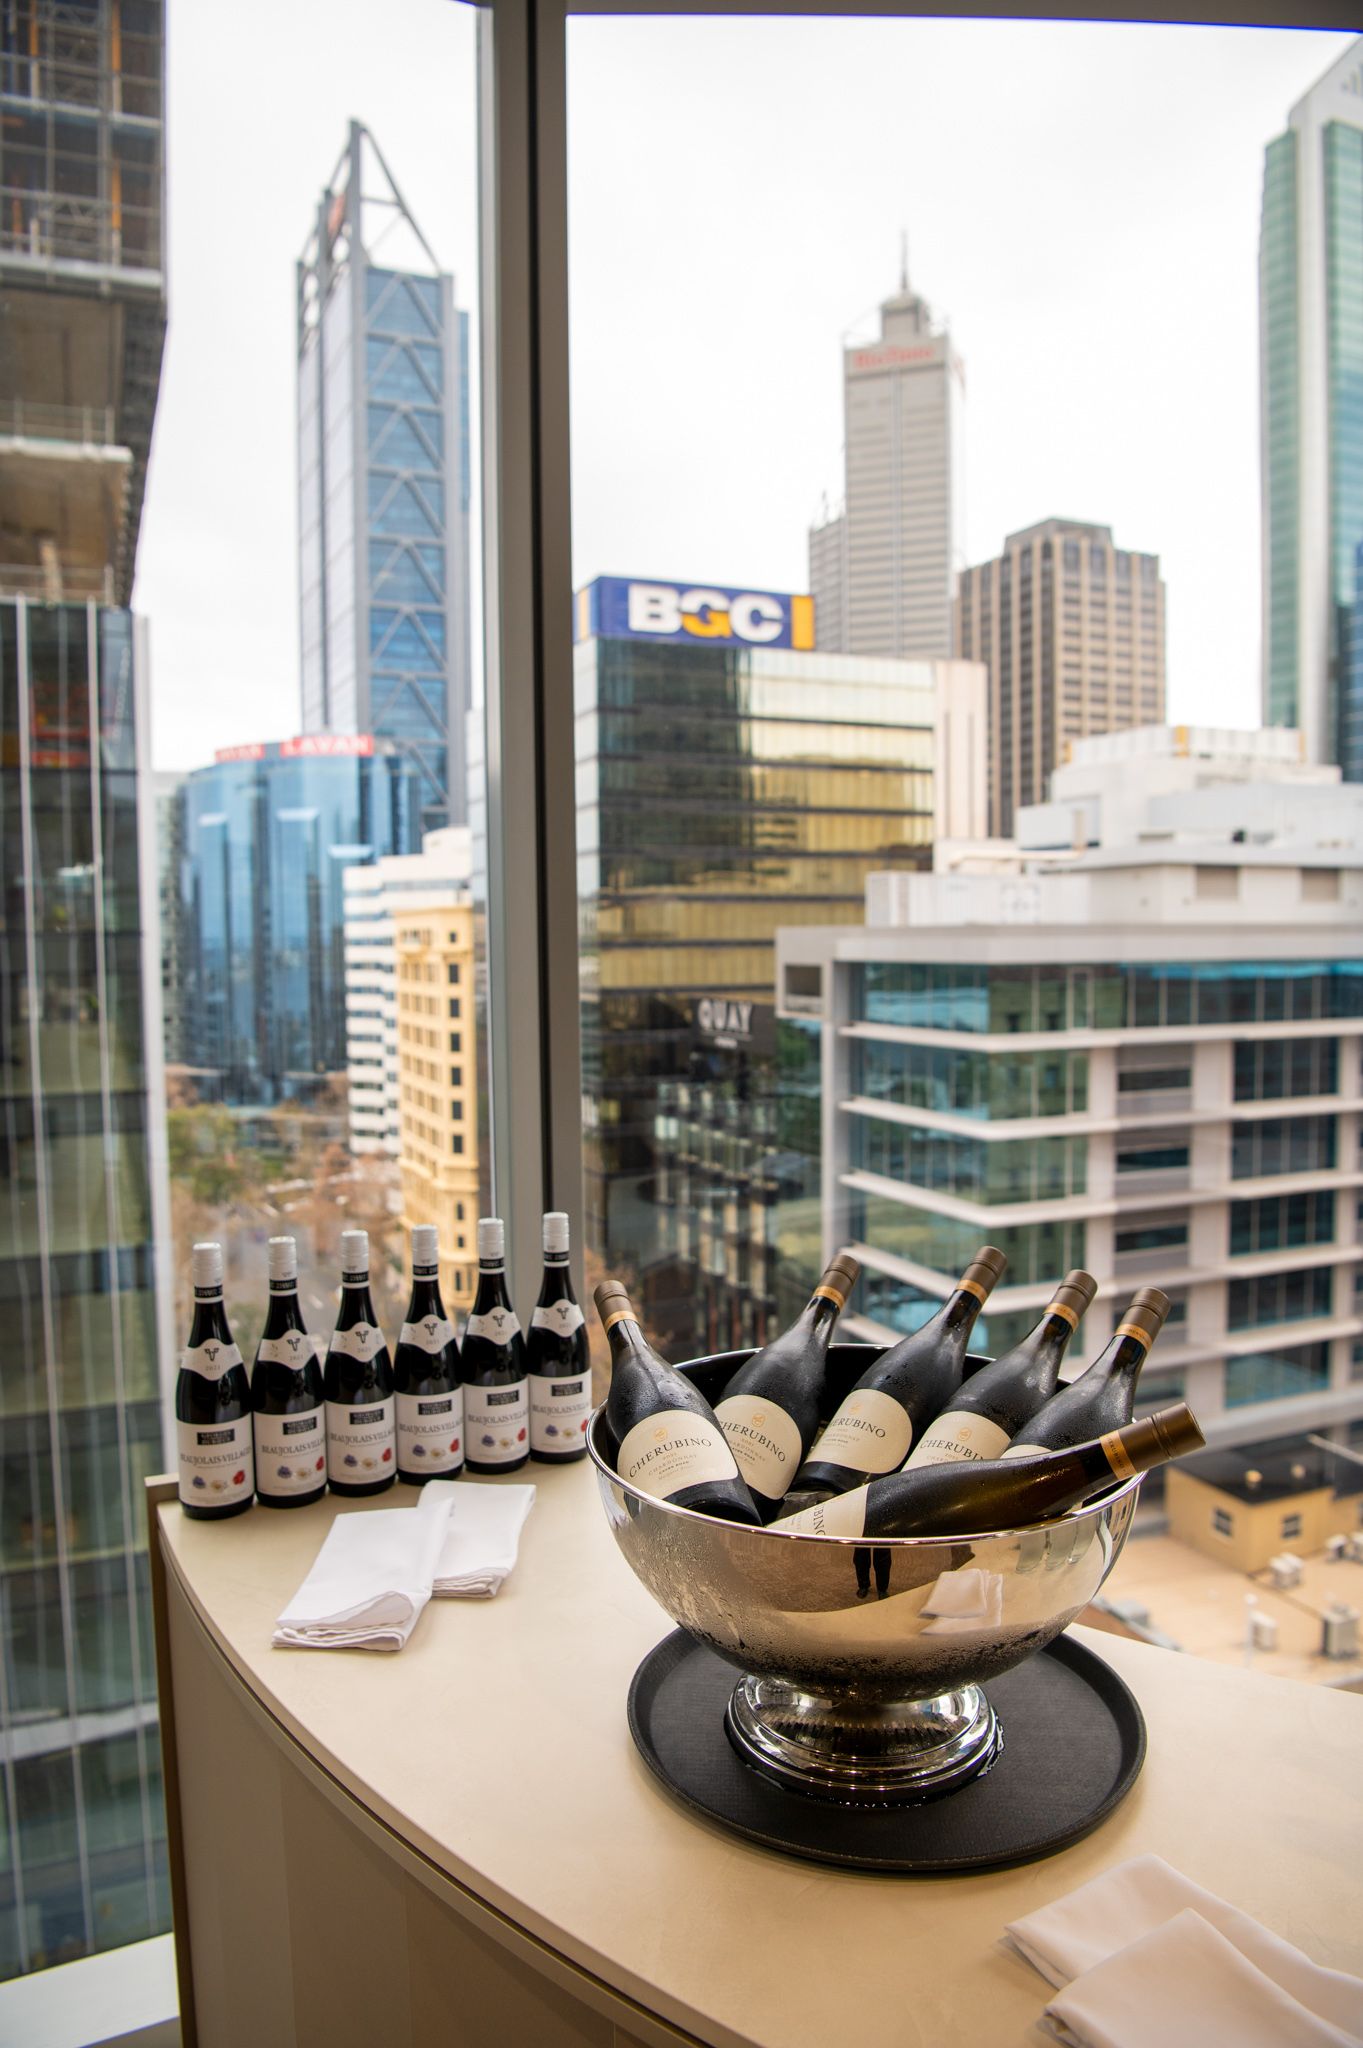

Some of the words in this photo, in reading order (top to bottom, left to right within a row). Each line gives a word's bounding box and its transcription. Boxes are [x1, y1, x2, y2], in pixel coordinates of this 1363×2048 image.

[628, 583, 784, 643] BGC
[698, 998, 752, 1033] QUAY
[629, 1437, 712, 1478] CHERUBINO
